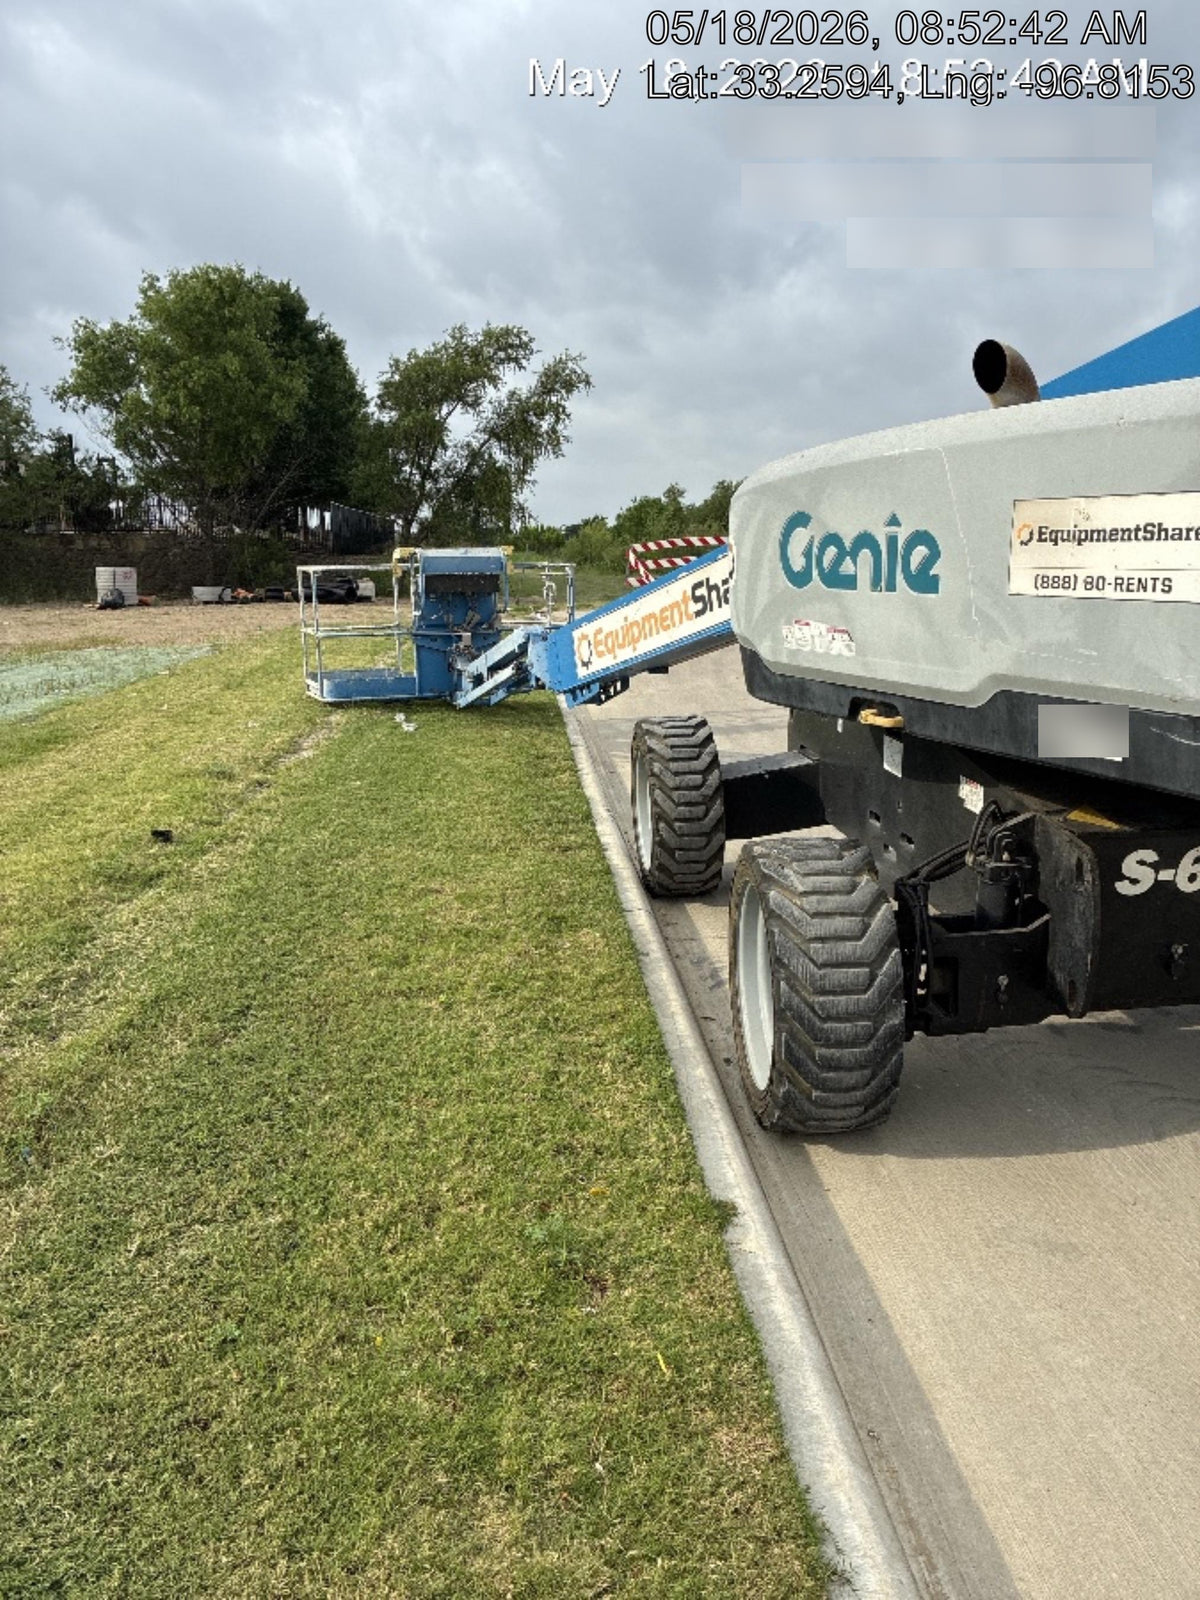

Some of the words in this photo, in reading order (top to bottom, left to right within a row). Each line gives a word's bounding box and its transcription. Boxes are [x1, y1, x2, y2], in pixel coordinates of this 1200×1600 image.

[779, 510, 941, 595] Genie
[1034, 574, 1078, 590] (888)
[1083, 575, 1173, 593] 80-RENTS
